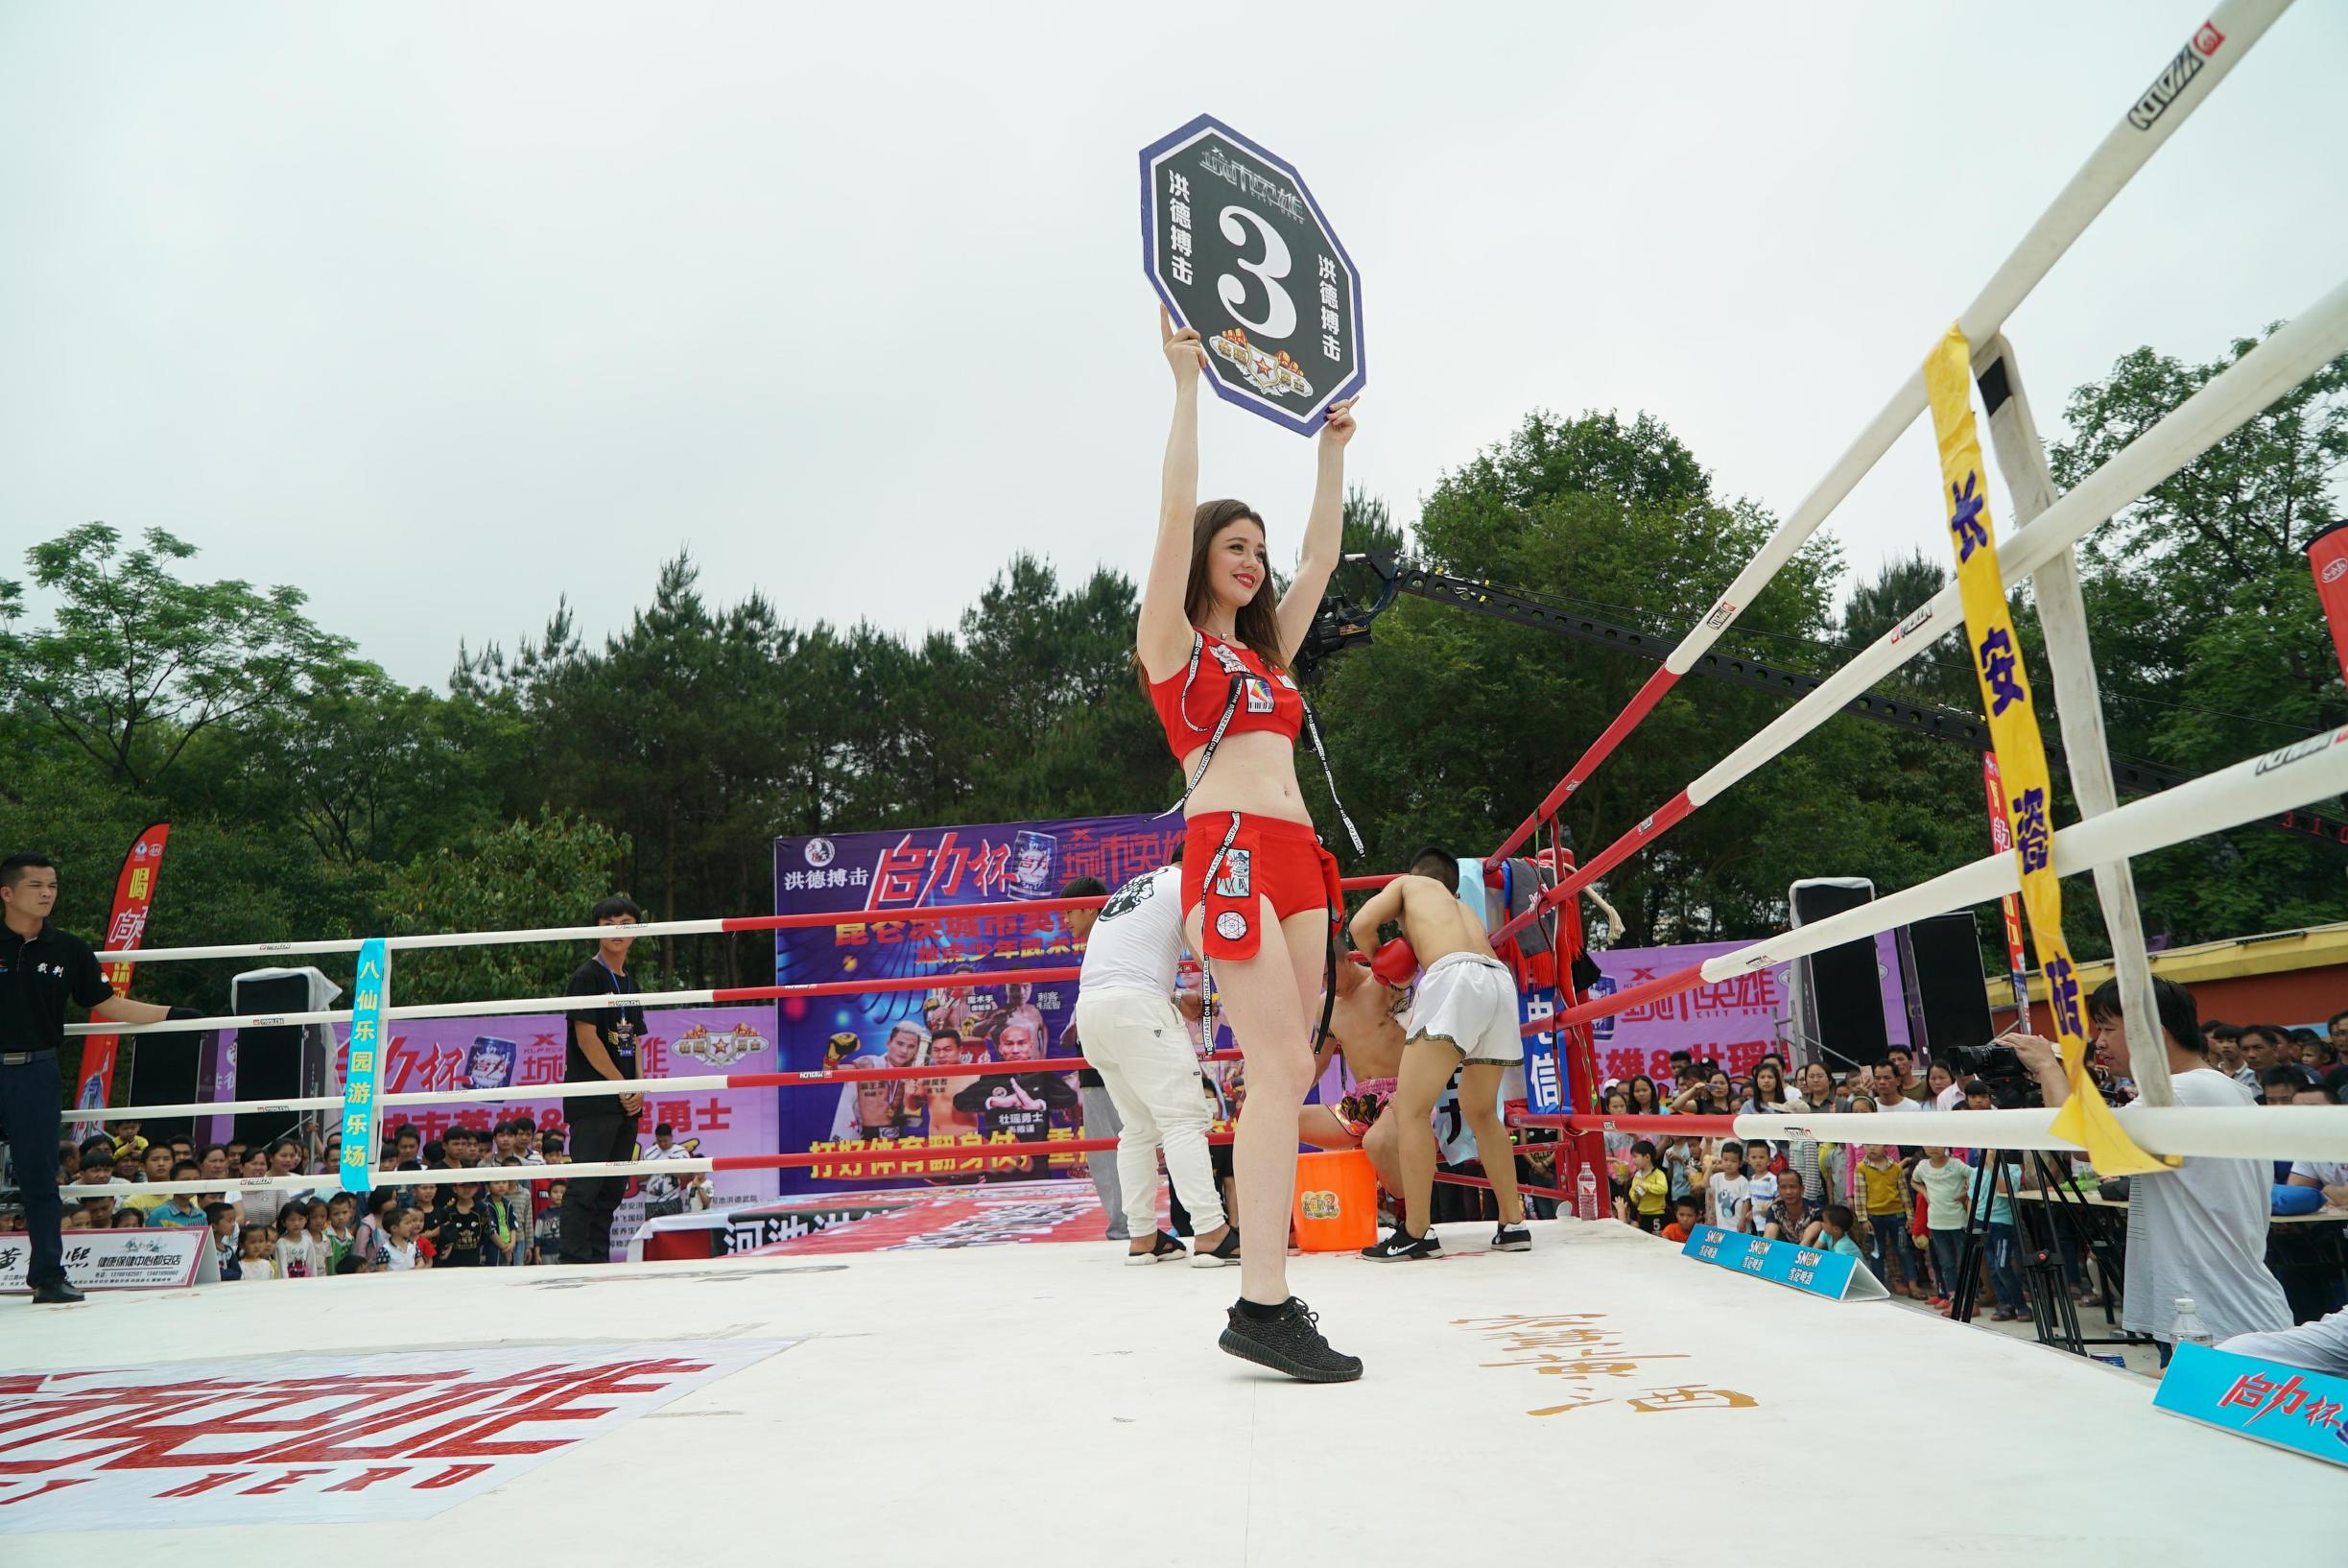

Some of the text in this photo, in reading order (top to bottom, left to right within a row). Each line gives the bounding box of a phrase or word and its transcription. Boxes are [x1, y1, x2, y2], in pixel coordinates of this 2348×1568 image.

[1168, 169, 1194, 286] 洪德搏击
[1217, 204, 1297, 340] 3
[1317, 253, 1341, 362] 洪德搏击
[783, 867, 870, 891] 洪德搏击
[343, 960, 380, 1168] 八仙乐园游乐场
[1652, 1218, 1661, 1232] 5
[1704, 1229, 1726, 1244] SNOW
[1747, 1239, 1772, 1255] SNOW
[1742, 1255, 1765, 1271] 雪花啤酒
[1794, 1249, 1823, 1268] SNOW
[1788, 1267, 1815, 1286] 雪花啤酒
[2217, 1370, 2343, 1430] 启力杯
